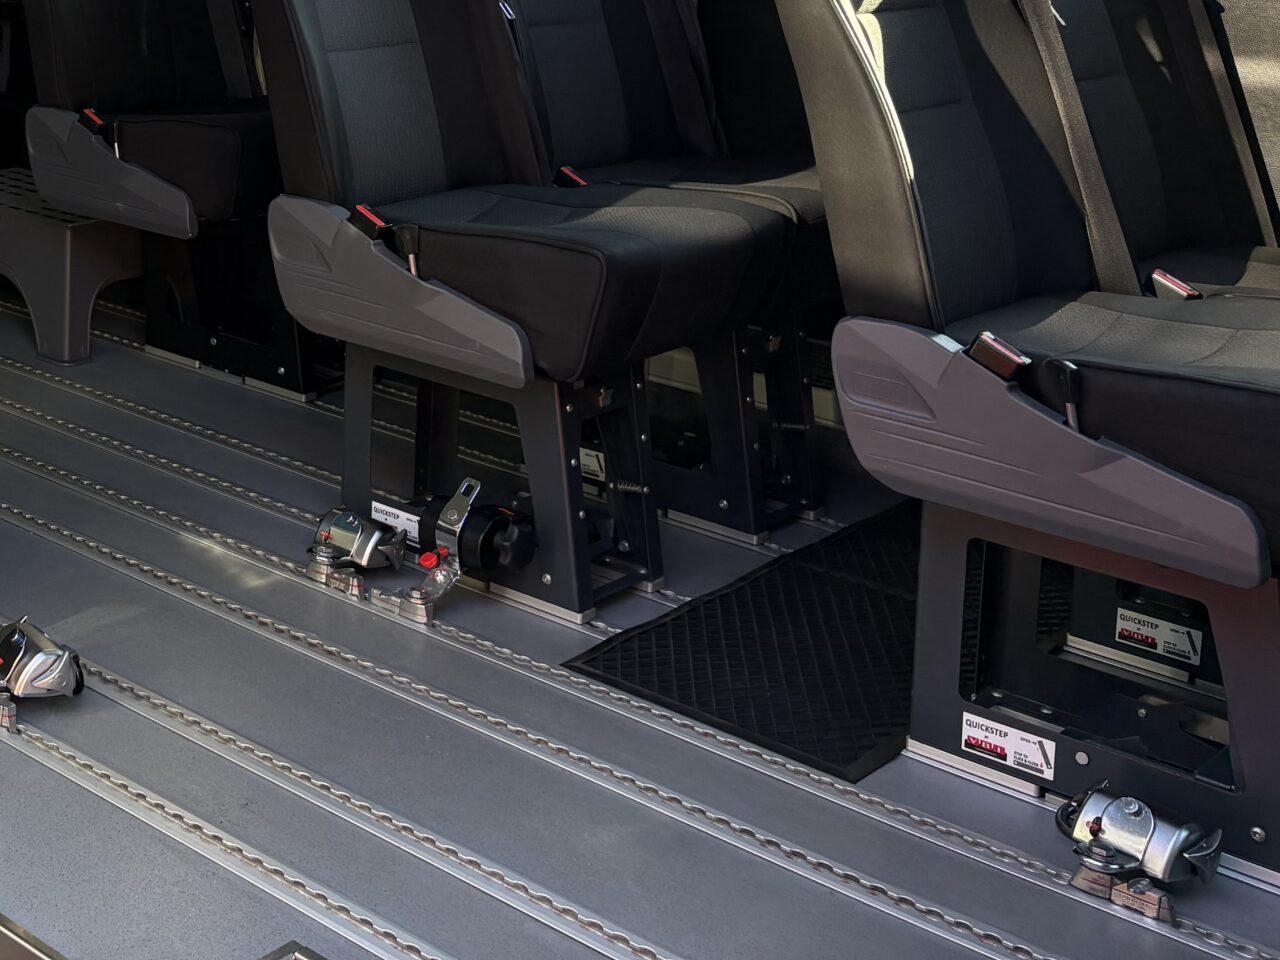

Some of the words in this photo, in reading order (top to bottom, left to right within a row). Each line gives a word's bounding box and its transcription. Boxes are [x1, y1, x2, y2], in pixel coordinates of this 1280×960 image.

[373, 506, 400, 520] QUICKSTEP
[1120, 613, 1159, 630] QUICKSTEP
[965, 718, 1009, 739] QUICKSTEP
